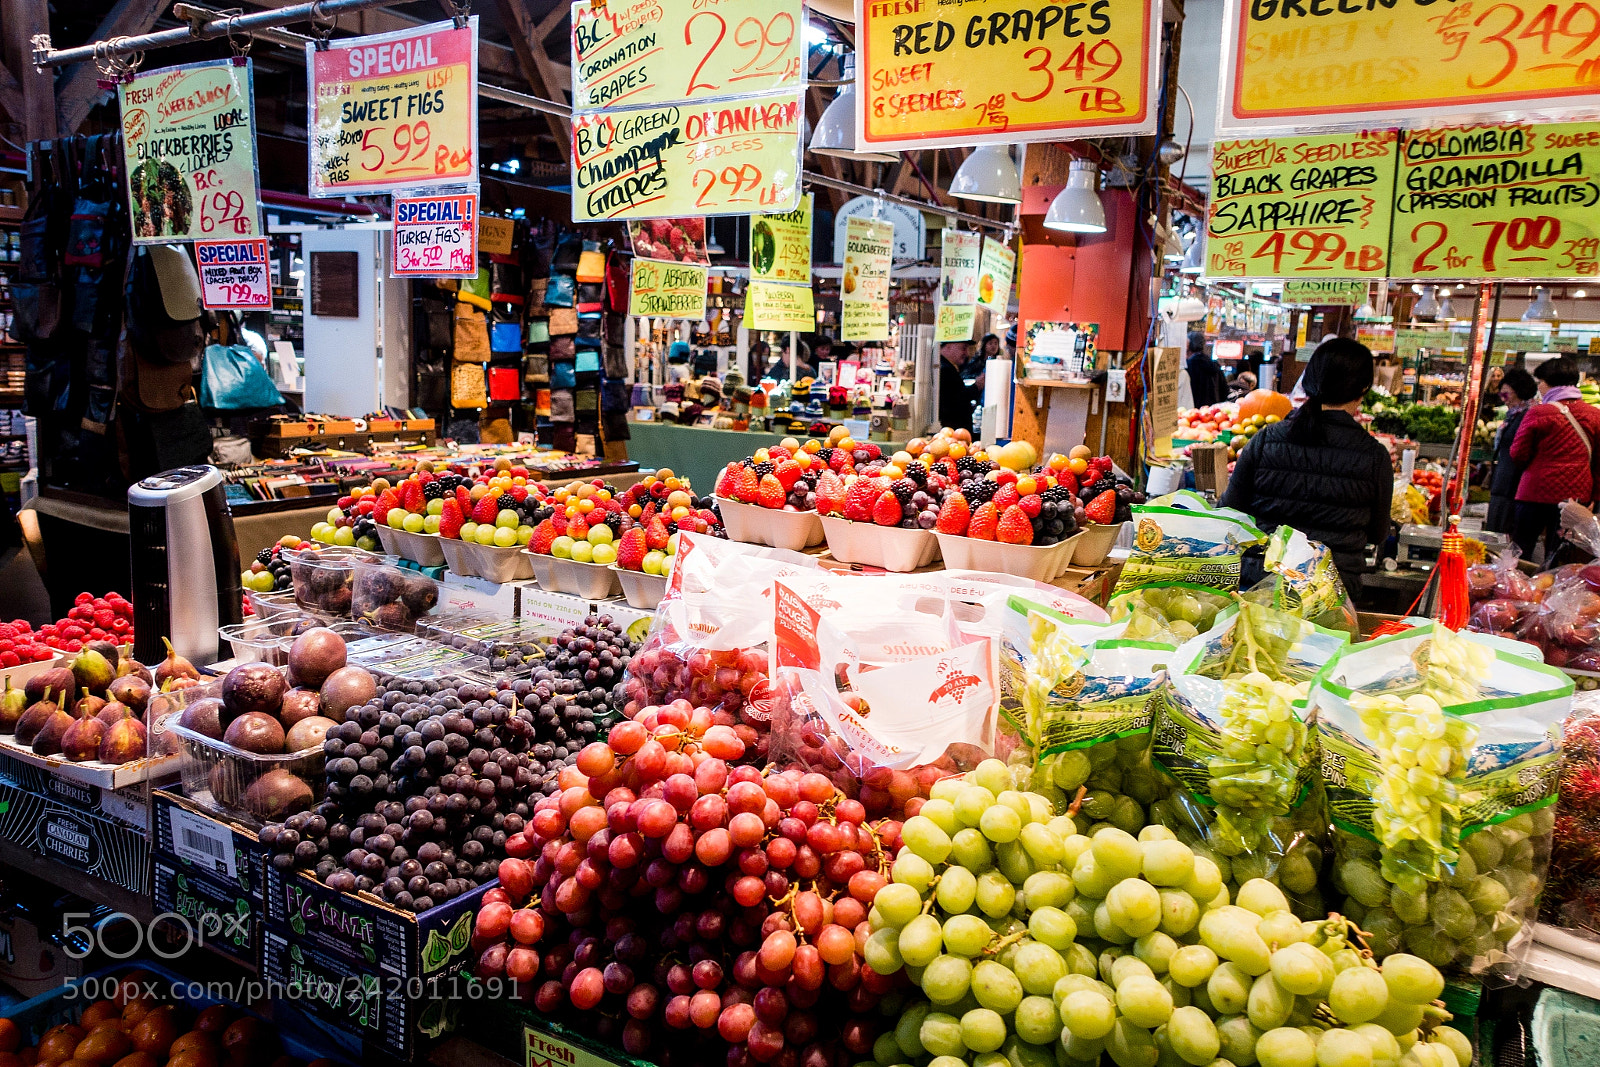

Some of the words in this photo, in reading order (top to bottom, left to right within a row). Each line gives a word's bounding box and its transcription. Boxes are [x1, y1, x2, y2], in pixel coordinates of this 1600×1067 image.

[872, 0, 925, 17] FRESH
[892, 20, 955, 56] RED
[965, 1, 1112, 49] GRAPES
[349, 36, 438, 78] SPECIAL
[578, 33, 656, 83] CORONATION
[426, 66, 454, 90] USA
[589, 66, 648, 105] GRAPES
[872, 61, 935, 91] SWEET
[125, 87, 153, 106] FRESH
[341, 95, 403, 124] SWEET
[407, 89, 444, 117] FIGS
[885, 88, 966, 118] SEEDLESS
[157, 98, 185, 123] SWEET
[137, 132, 233, 160] BLACKBERRIES
[1214, 147, 1266, 171] SWEET
[1274, 147, 1288, 163] &
[1292, 141, 1391, 164] SEEDLESS
[1407, 129, 1523, 159] COLOMBIA
[1214, 173, 1283, 198] BLACK
[1290, 166, 1378, 191] GRAPES
[1406, 152, 1582, 191] GRANADILLA
[1397, 188, 1497, 213] (PASSION
[1509, 182, 1600, 207] FRUITS)
[398, 201, 462, 222] SPECIAL
[1210, 199, 1361, 234] SAPPHIRE
[396, 229, 432, 247] TURKEY
[1411, 221, 1448, 273] 2
[1443, 246, 1474, 269] for
[199, 244, 257, 263] SPECIAL
[1344, 245, 1385, 271] LB
[205, 267, 227, 277] MIXED
[638, 292, 703, 314] STRAWBERRIES
[526, 598, 541, 606] FUSS
[531, 611, 557, 623] VITAMIN
[943, 682, 953, 692] 70
[954, 677, 969, 688] ANS
[48, 778, 92, 804] CHERRIES
[47, 822, 89, 849] CANADIAN
[57, 817, 79, 832] FRESH
[45, 836, 90, 863] CHERRIES
[528, 1033, 576, 1064] Fresh
